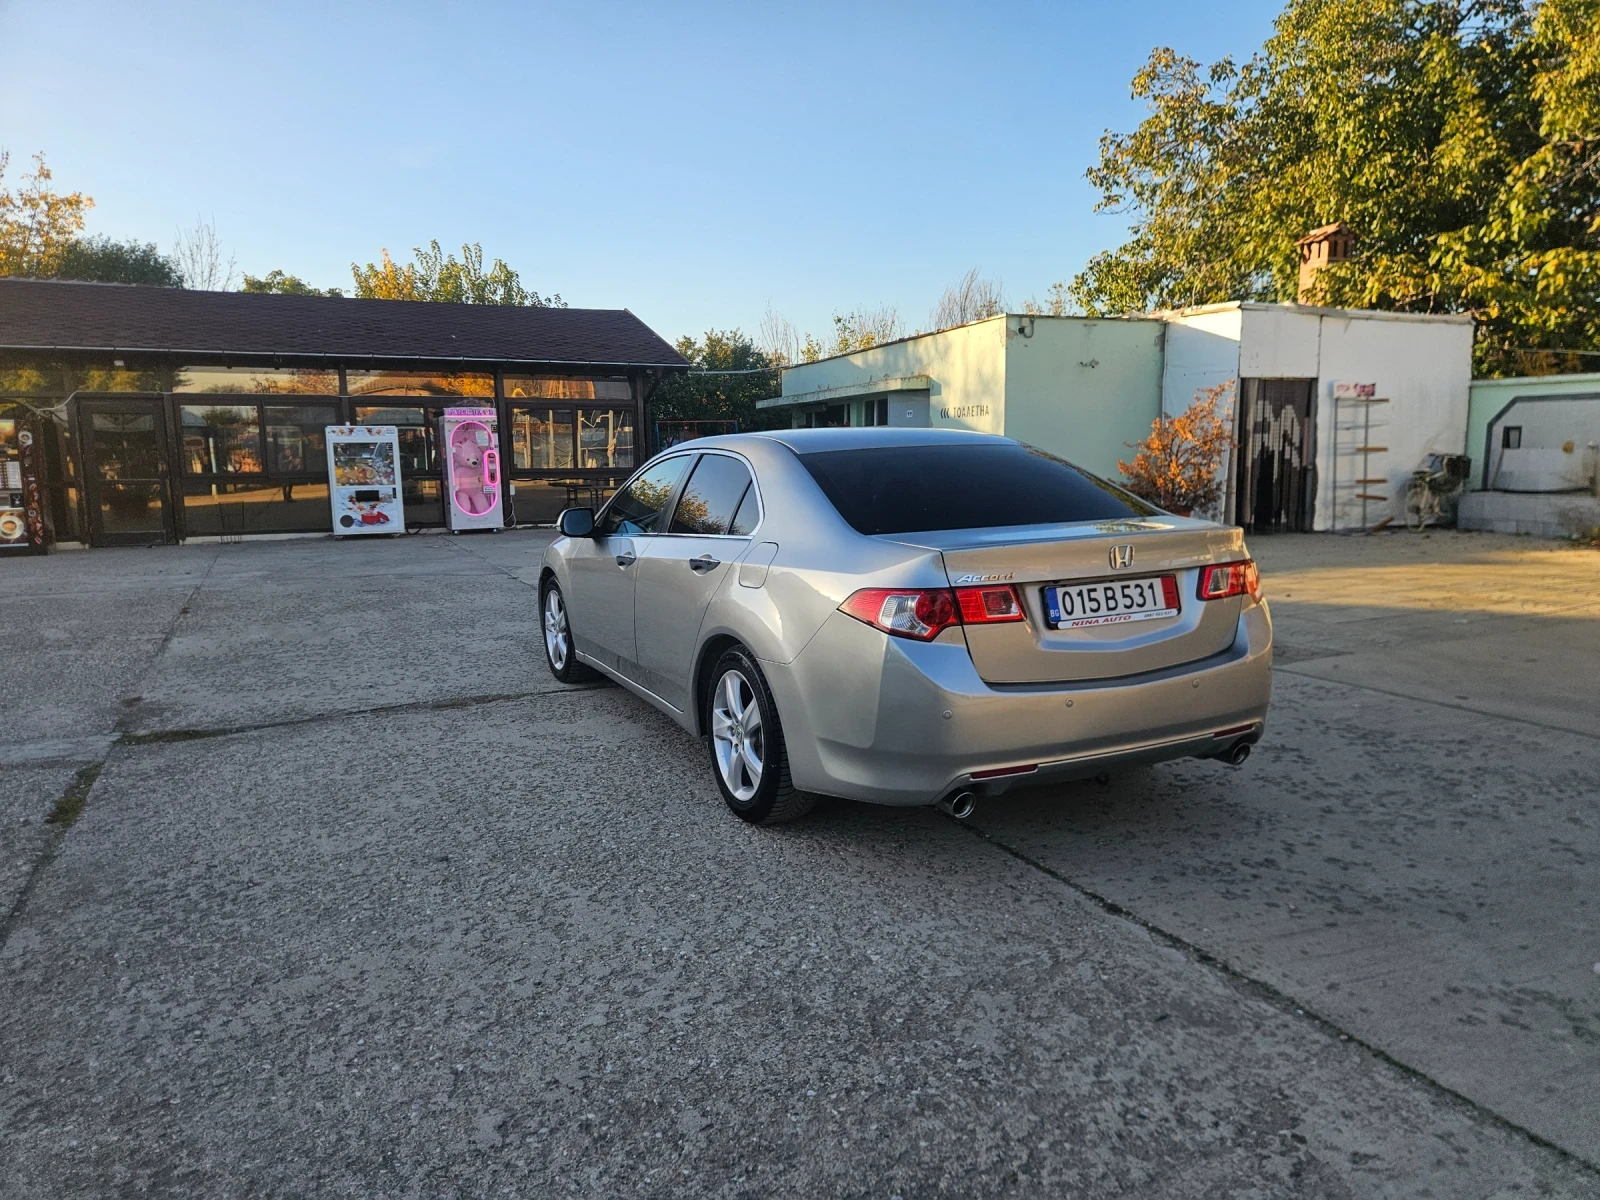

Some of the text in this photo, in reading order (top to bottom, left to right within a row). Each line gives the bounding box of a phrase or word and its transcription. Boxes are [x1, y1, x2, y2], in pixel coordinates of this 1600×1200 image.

[955, 571, 1016, 583] Accord
[1050, 609, 1060, 618] BG
[1071, 615, 1132, 627] NINA AUTO
